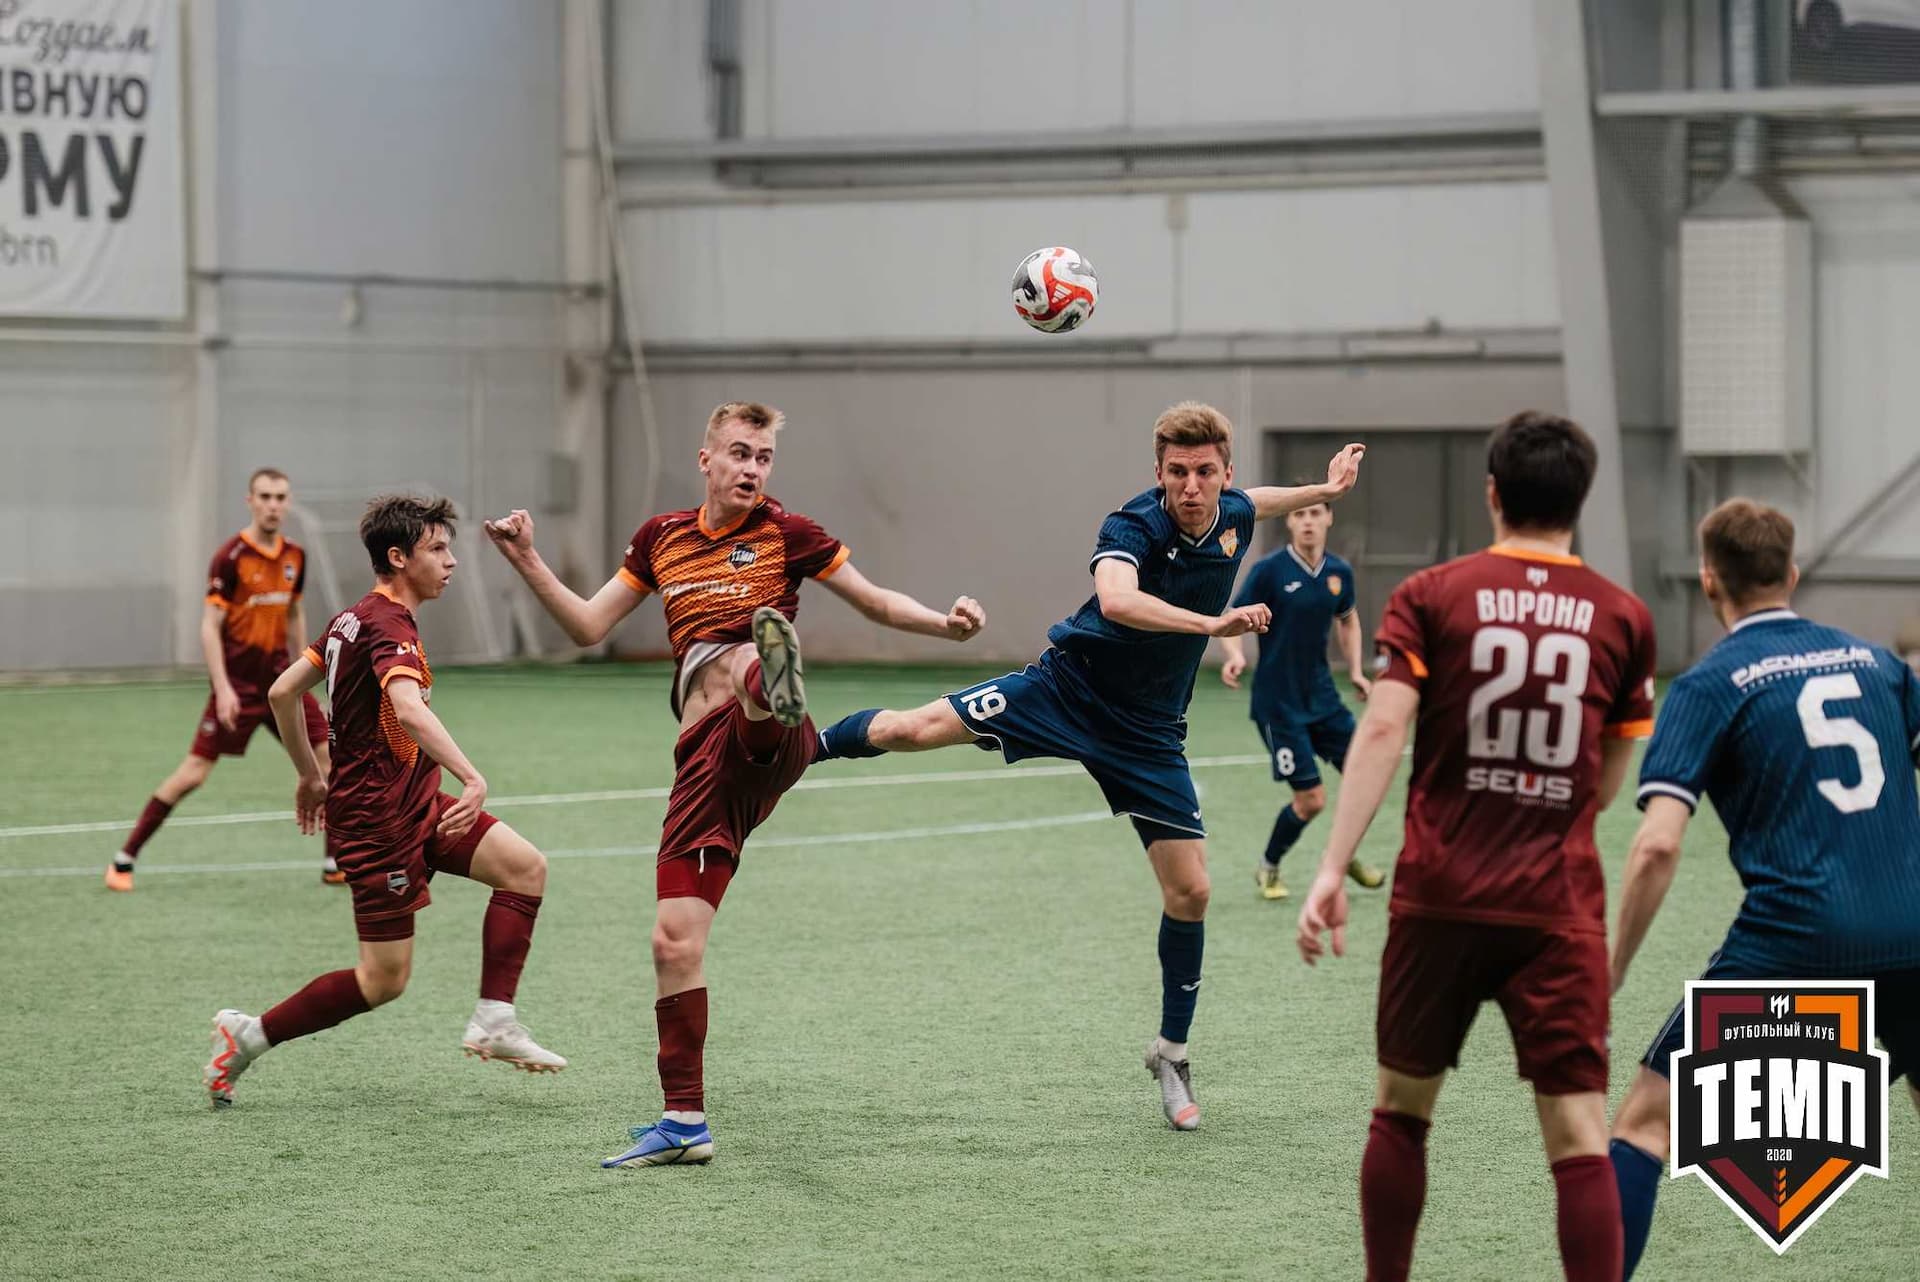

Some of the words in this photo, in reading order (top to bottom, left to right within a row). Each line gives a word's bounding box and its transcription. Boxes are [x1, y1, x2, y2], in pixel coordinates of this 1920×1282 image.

[0, 69, 148, 120] ВНУЮ
[0, 130, 145, 220] МУ
[1475, 588, 1595, 634] ВОРОНА
[960, 684, 1007, 721] 19
[1467, 625, 1591, 768] 23
[1276, 747, 1296, 777] 8
[1796, 671, 1886, 814] 5
[1466, 767, 1574, 801] SEUS
